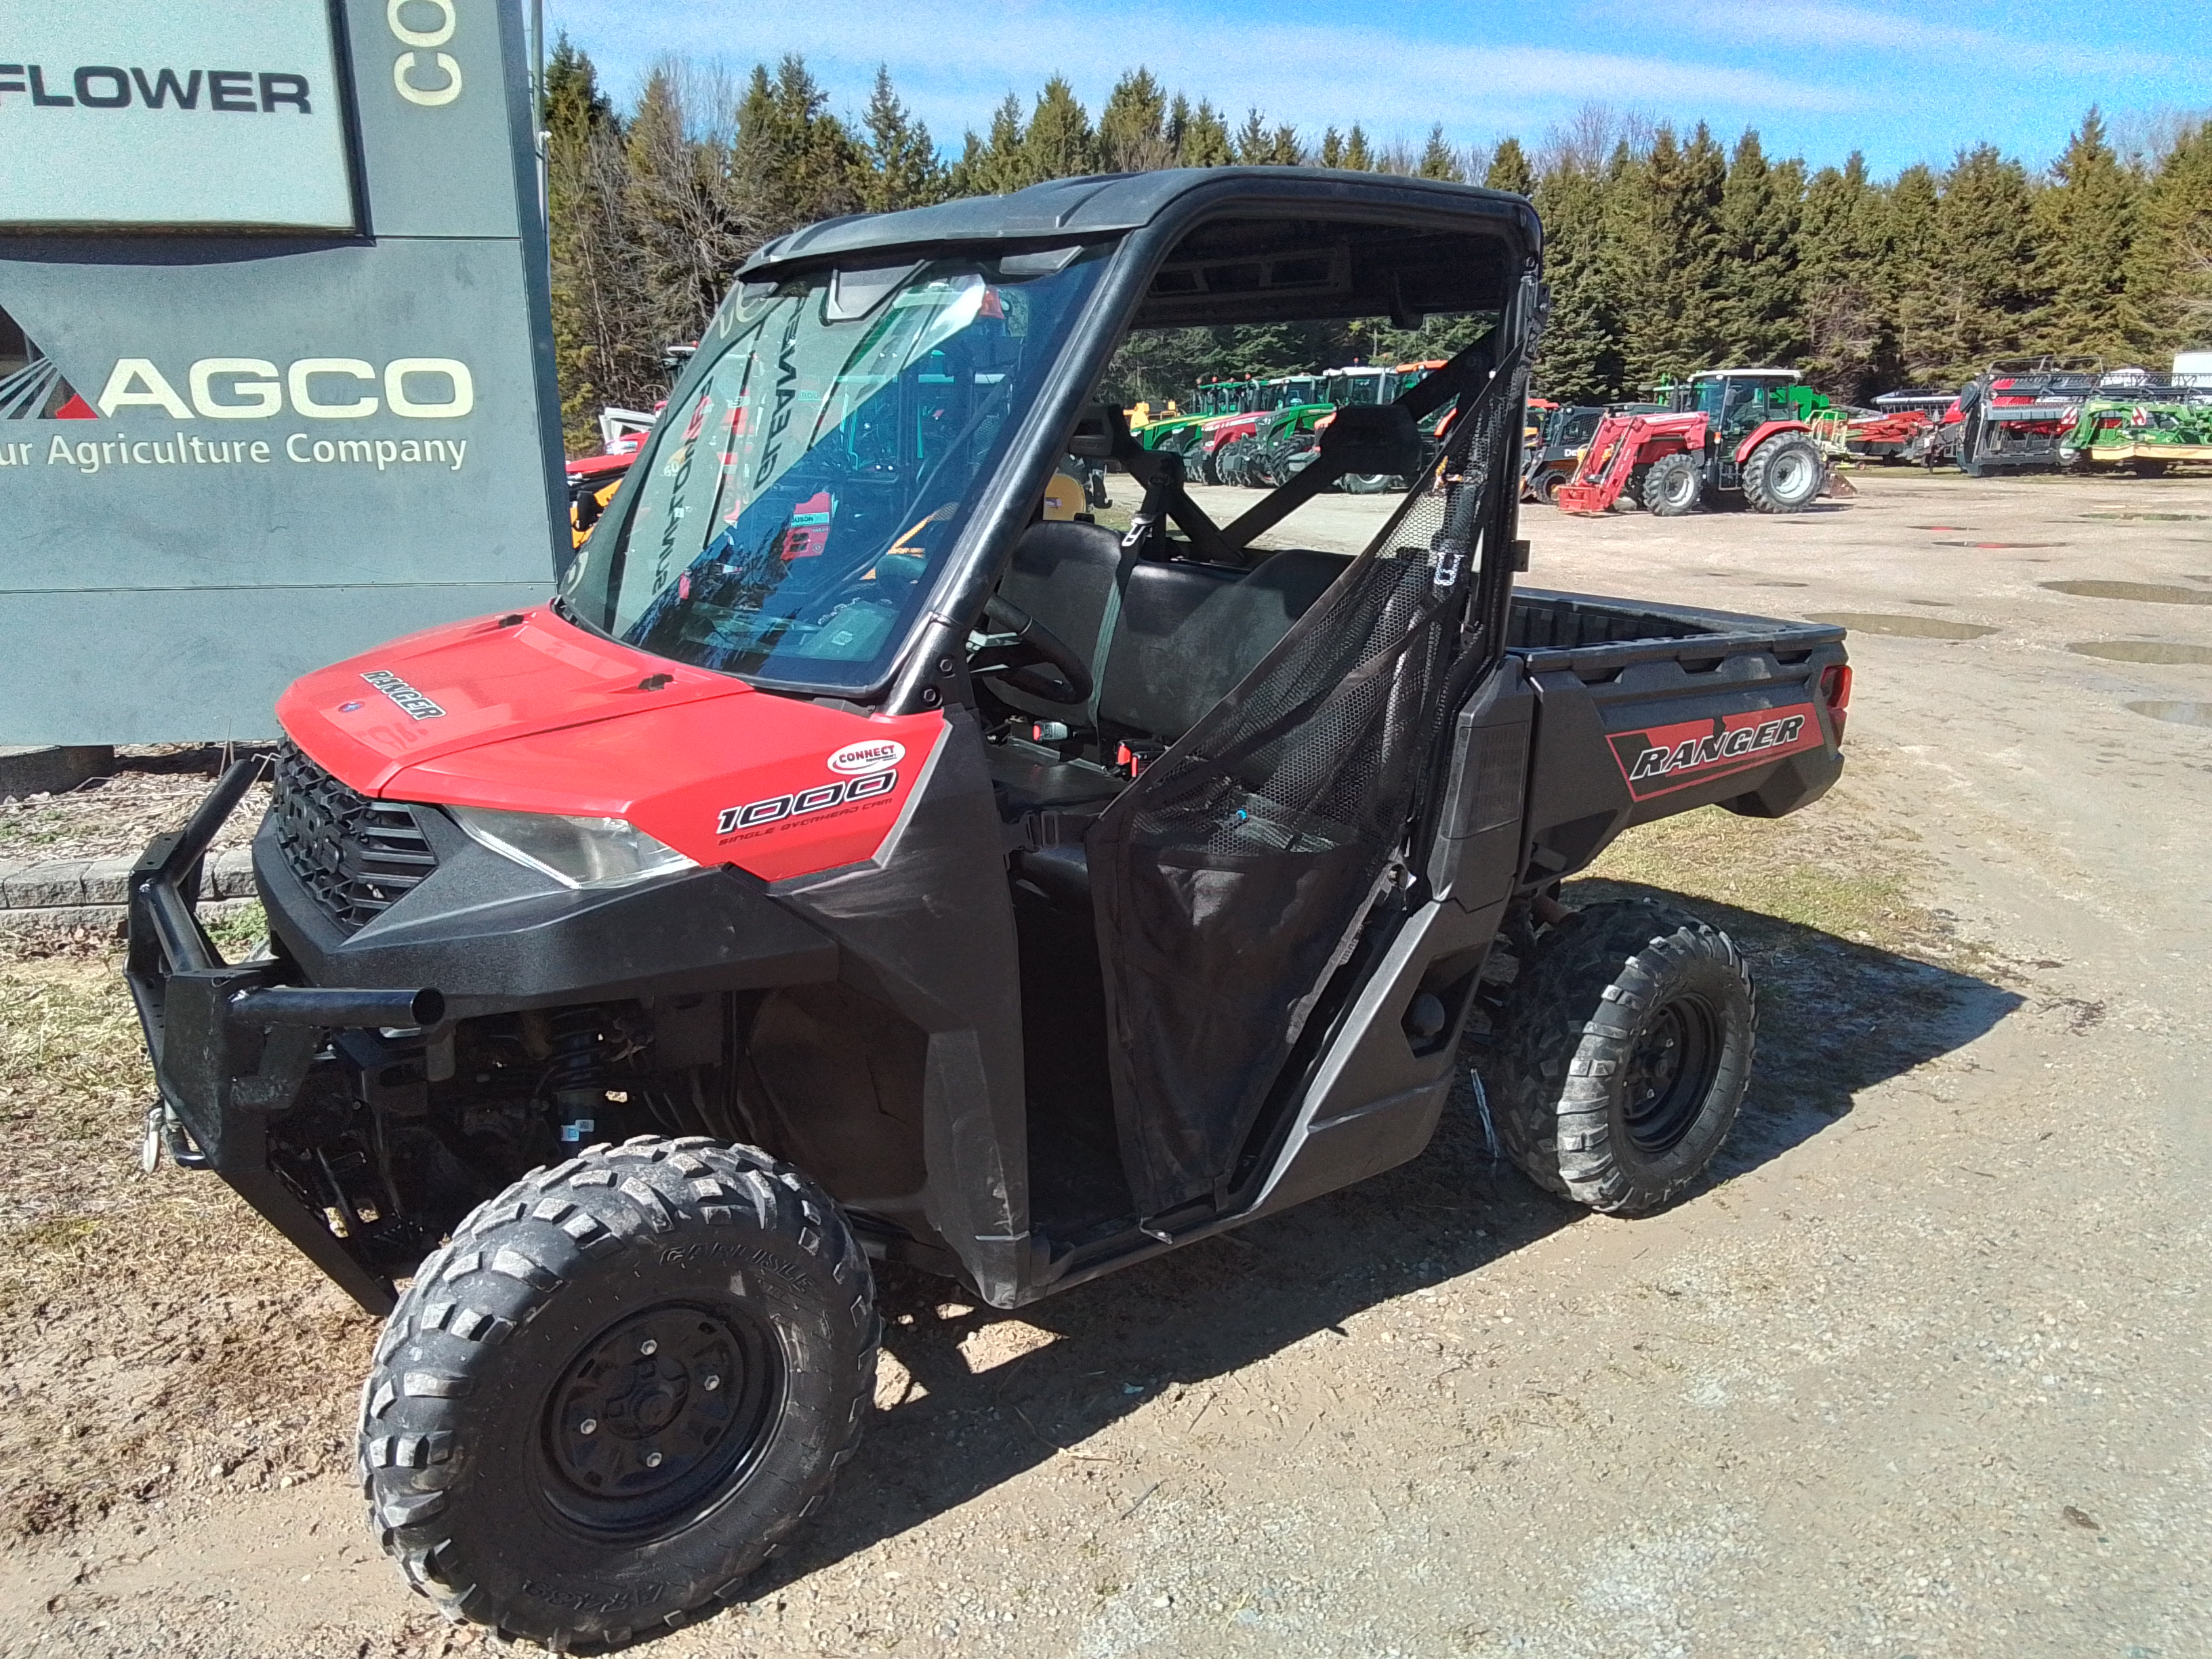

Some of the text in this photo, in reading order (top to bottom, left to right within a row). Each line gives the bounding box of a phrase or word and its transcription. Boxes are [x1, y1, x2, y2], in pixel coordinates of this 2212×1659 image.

[97, 358, 474, 419] AGCO
[47, 432, 270, 474] Agriculture
[286, 433, 467, 470] Company
[359, 670, 447, 720] RANGER
[838, 745, 895, 764] CONNECT
[1629, 714, 1805, 781] RANGER
[716, 769, 899, 835] 1000
[718, 798, 893, 846] SINGLE OVERHEAD CAM
